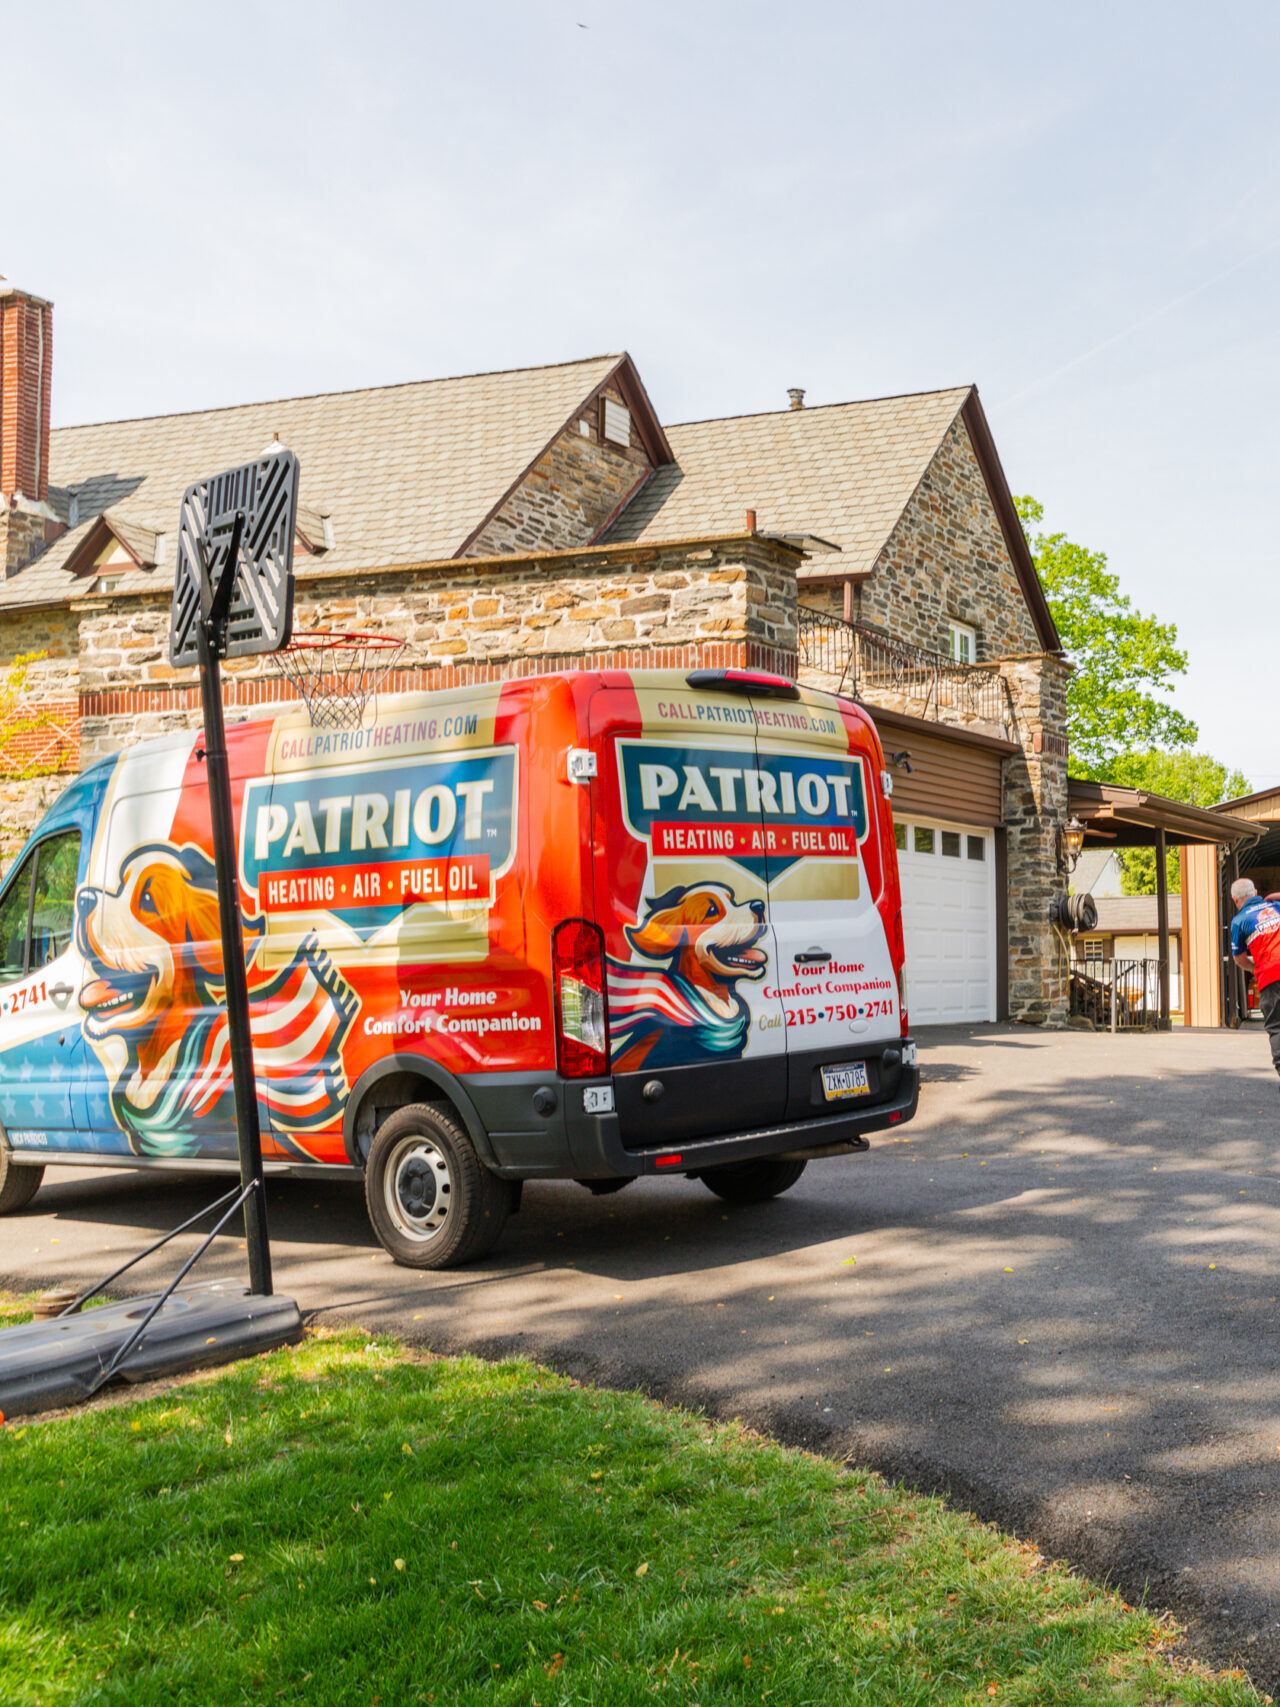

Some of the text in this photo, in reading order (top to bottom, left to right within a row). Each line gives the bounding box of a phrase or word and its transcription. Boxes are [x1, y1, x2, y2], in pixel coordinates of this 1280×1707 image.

[658, 702, 837, 735] CALLPATRIOTHEATING.COM
[281, 714, 478, 760] CALLPATRIOTHEATING.COM
[639, 764, 852, 817] PATRIOT
[253, 779, 495, 861] PATRIOT
[663, 828, 850, 851] HEATING AIR FUEL OIL
[268, 865, 478, 905] HEATING AIR FUEL OIL
[792, 961, 865, 977] Your Home
[400, 987, 497, 1008] Your Home
[763, 977, 892, 999] Comfort Companion
[364, 1012, 541, 1037] Comfort Companion
[758, 1014, 782, 1031] Call
